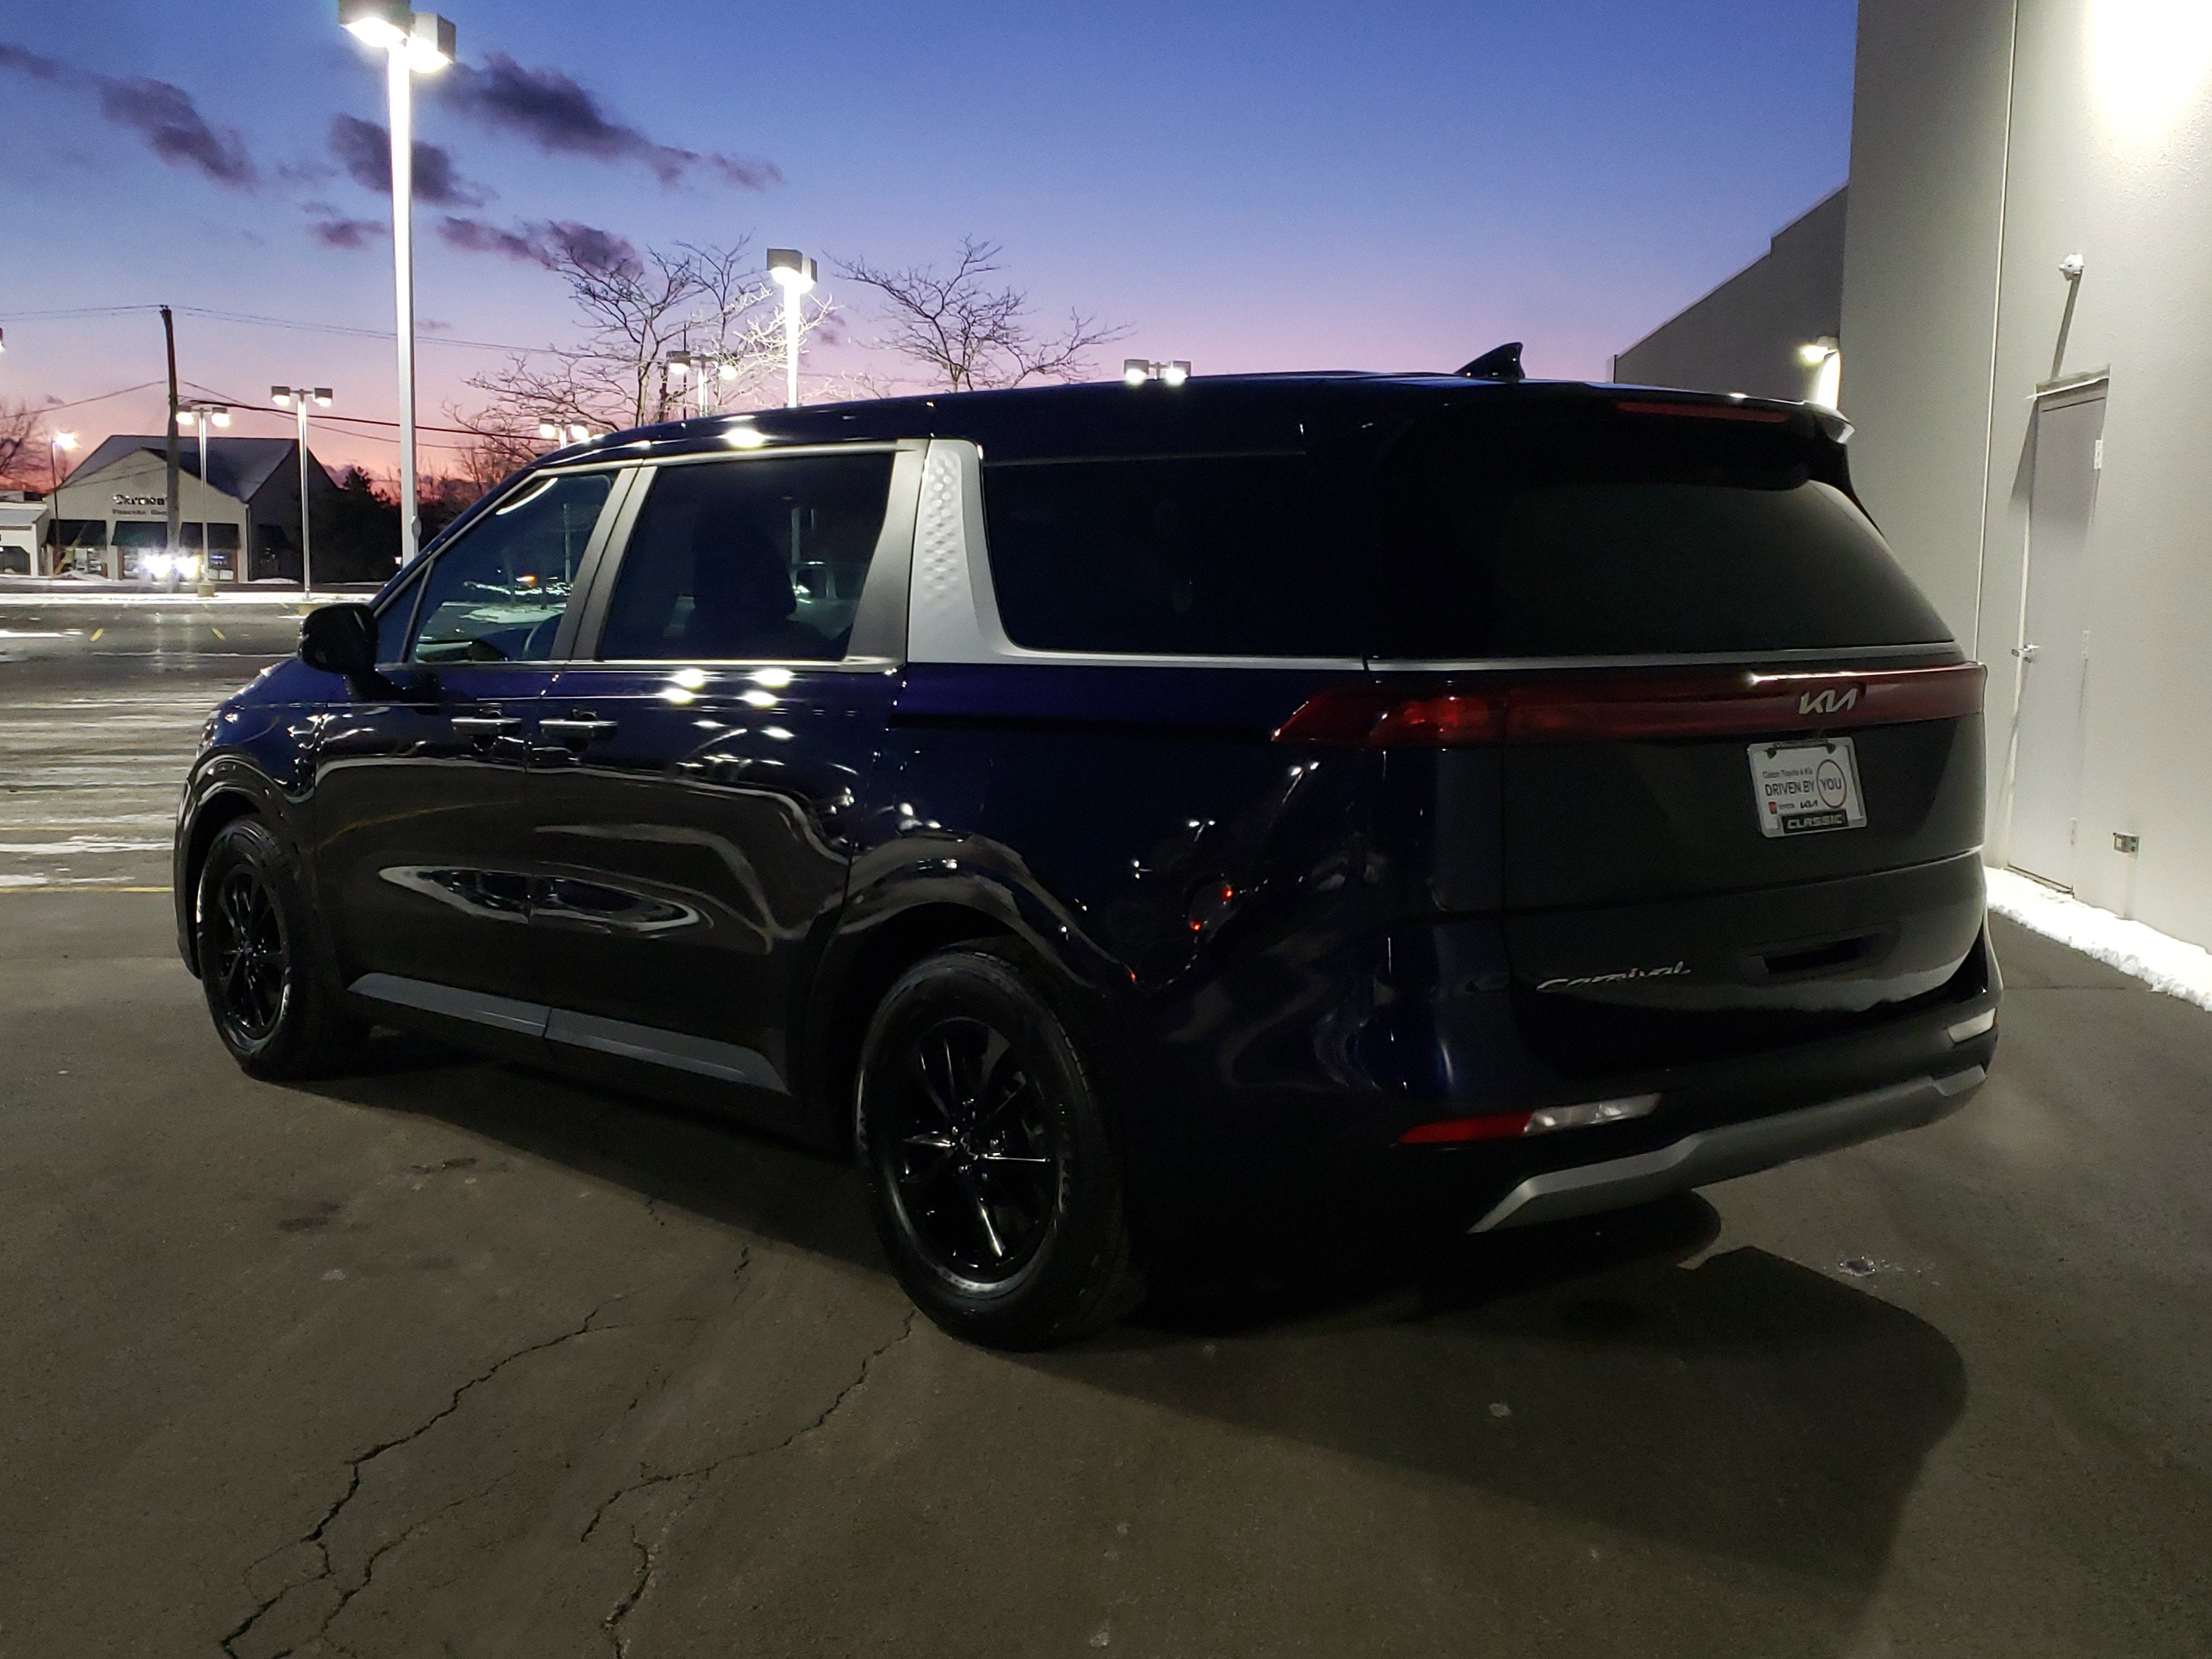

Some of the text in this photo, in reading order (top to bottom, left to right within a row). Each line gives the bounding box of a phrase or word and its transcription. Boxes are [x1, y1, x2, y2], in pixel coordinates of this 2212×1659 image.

[1799, 688, 1857, 714] KIA
[1765, 778, 1842, 796] DRIVEN BY YOU
[1787, 814, 1842, 829] CLASSIC
[1537, 961, 1691, 992] Carnival
